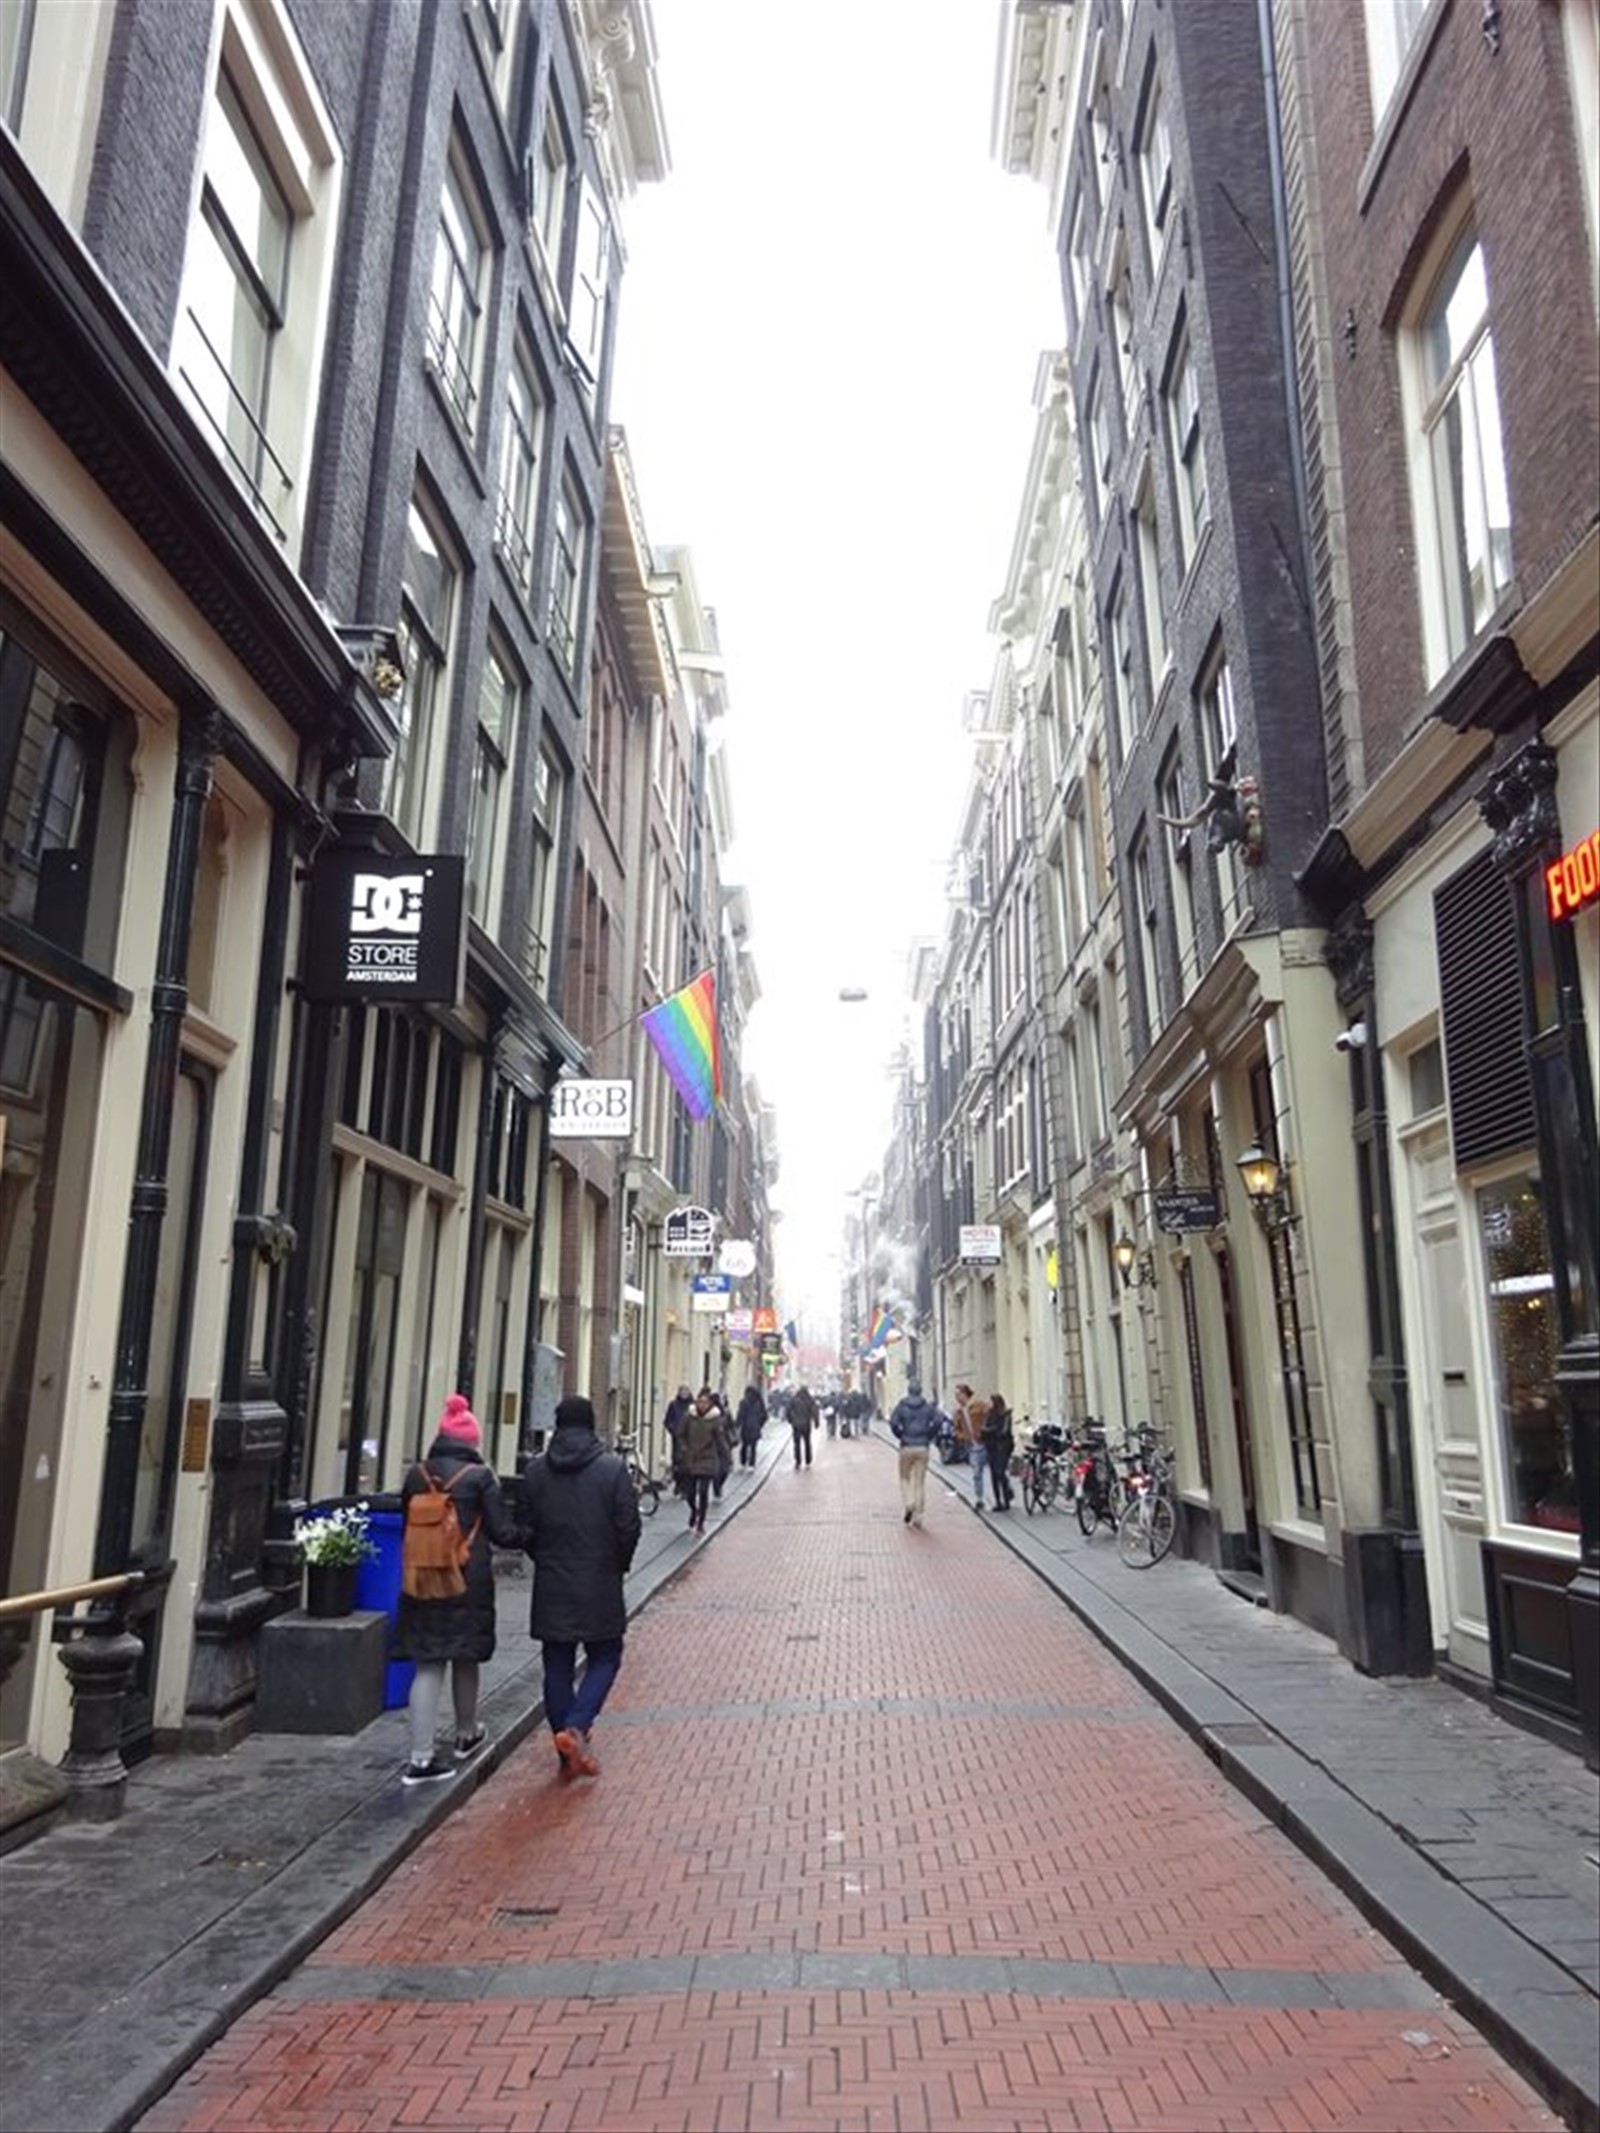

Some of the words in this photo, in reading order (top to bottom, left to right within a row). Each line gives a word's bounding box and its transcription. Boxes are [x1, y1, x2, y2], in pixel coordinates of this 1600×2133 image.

[350, 874, 424, 933] DC
[348, 945, 418, 965] STORE
[345, 970, 417, 982] AMSTERDAM
